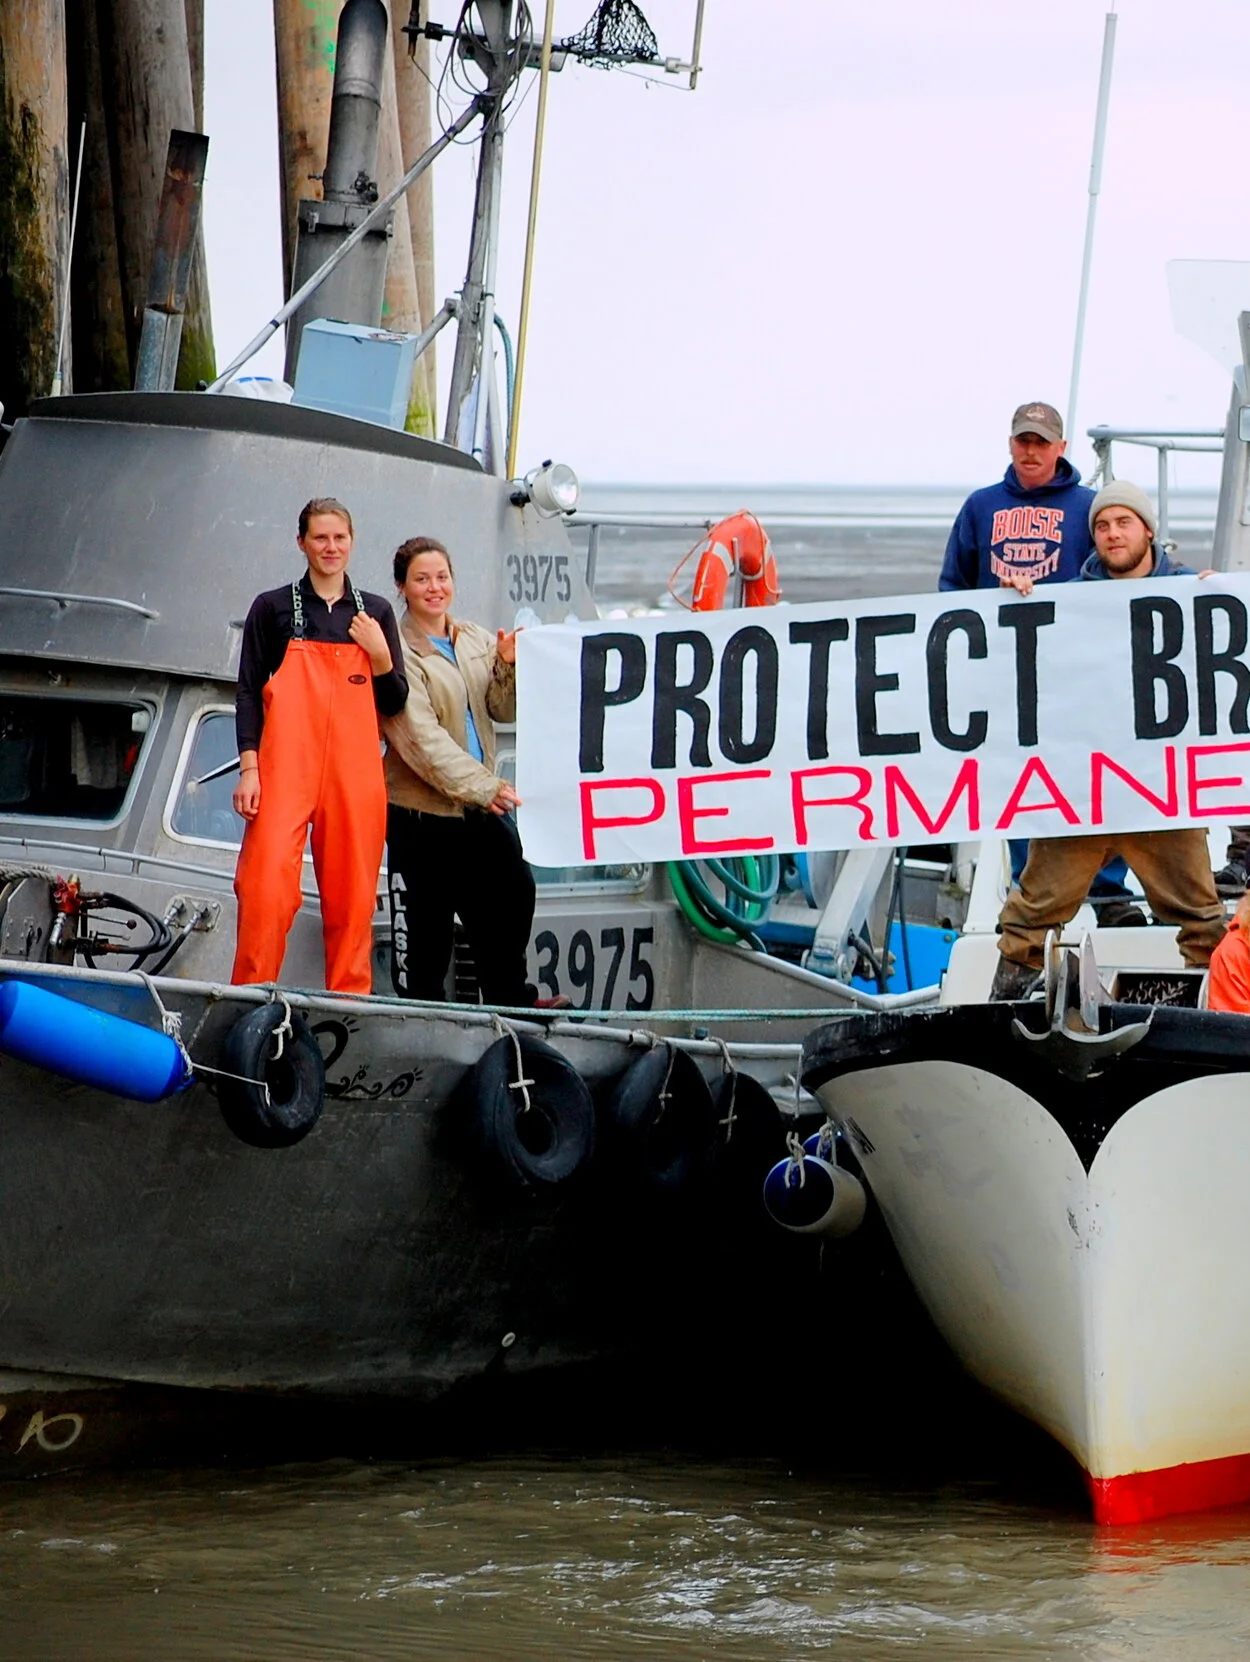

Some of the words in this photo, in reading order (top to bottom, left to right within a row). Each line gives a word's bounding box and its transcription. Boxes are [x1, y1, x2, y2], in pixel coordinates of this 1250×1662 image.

[991, 506, 1064, 546] BOISE
[1003, 542, 1046, 562] STATE
[507, 554, 571, 602] 3975
[579, 601, 1056, 773] PROTECT
[391, 872, 408, 990] ALASKA
[535, 926, 655, 1023] 3975
